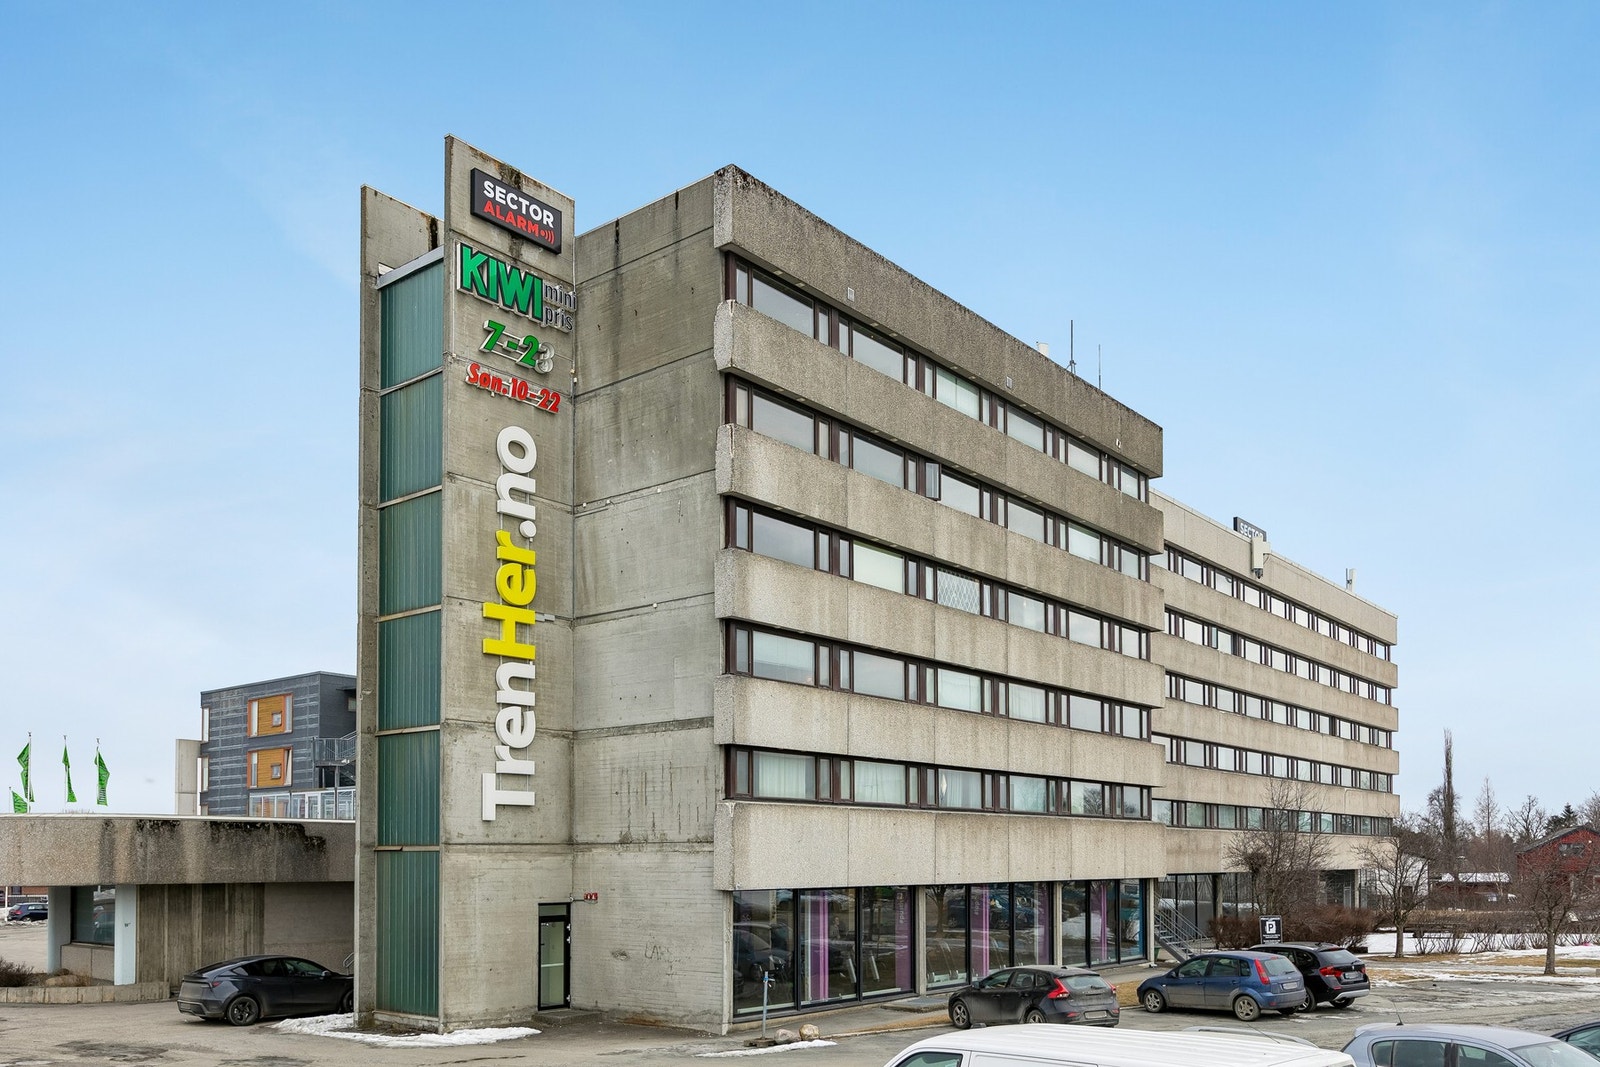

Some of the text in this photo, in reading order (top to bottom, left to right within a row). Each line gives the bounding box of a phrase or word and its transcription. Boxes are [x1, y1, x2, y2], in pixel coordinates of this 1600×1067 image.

[483, 180, 554, 228] SECTOR
[483, 199, 540, 237] ALARM
[457, 242, 544, 323] KIWI
[544, 282, 577, 311] mini
[545, 305, 574, 333] pris
[482, 425, 537, 821] TrenHer.no
